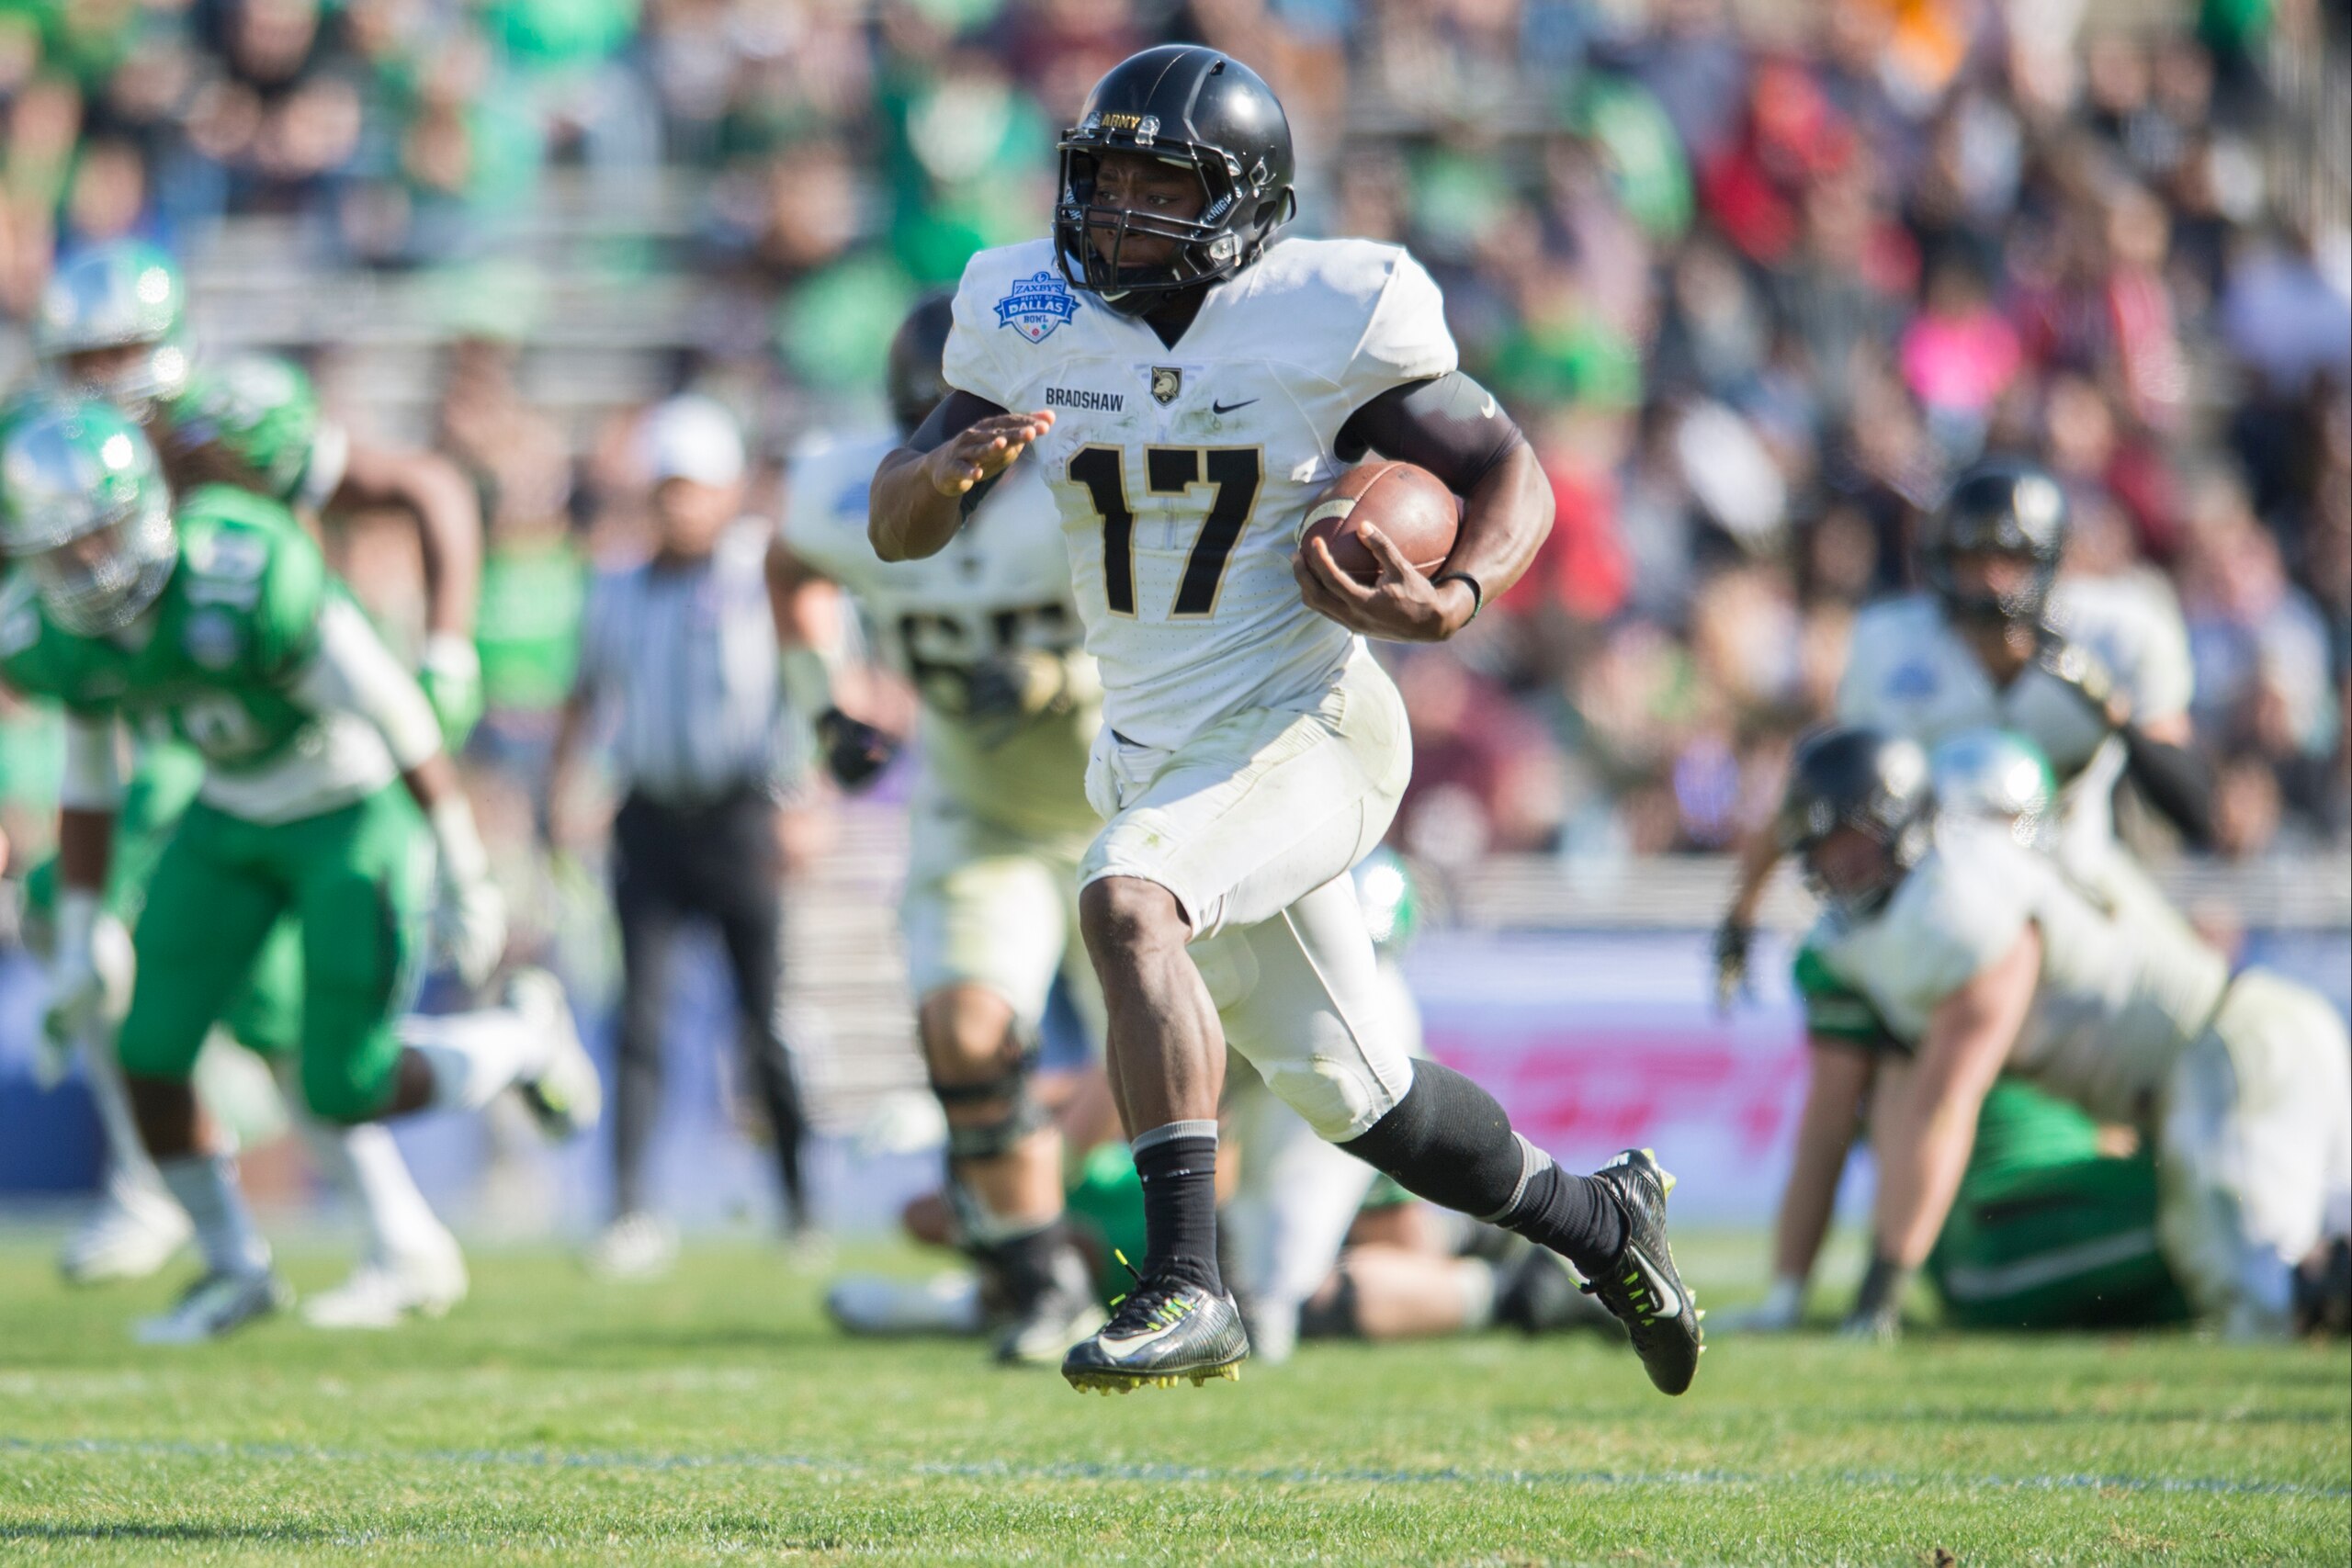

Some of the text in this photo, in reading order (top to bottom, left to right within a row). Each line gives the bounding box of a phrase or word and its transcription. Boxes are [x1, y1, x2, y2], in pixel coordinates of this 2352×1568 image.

[1101, 113, 1141, 130] ARMY
[1205, 186, 1243, 222] KNIGHS
[1015, 284, 1063, 295] ZAXBY'S
[1009, 301, 1063, 313] DALLAS
[1023, 315, 1048, 323] BOWL
[1046, 388, 1124, 412] BRADSHAW
[1066, 442, 1266, 620] 17
